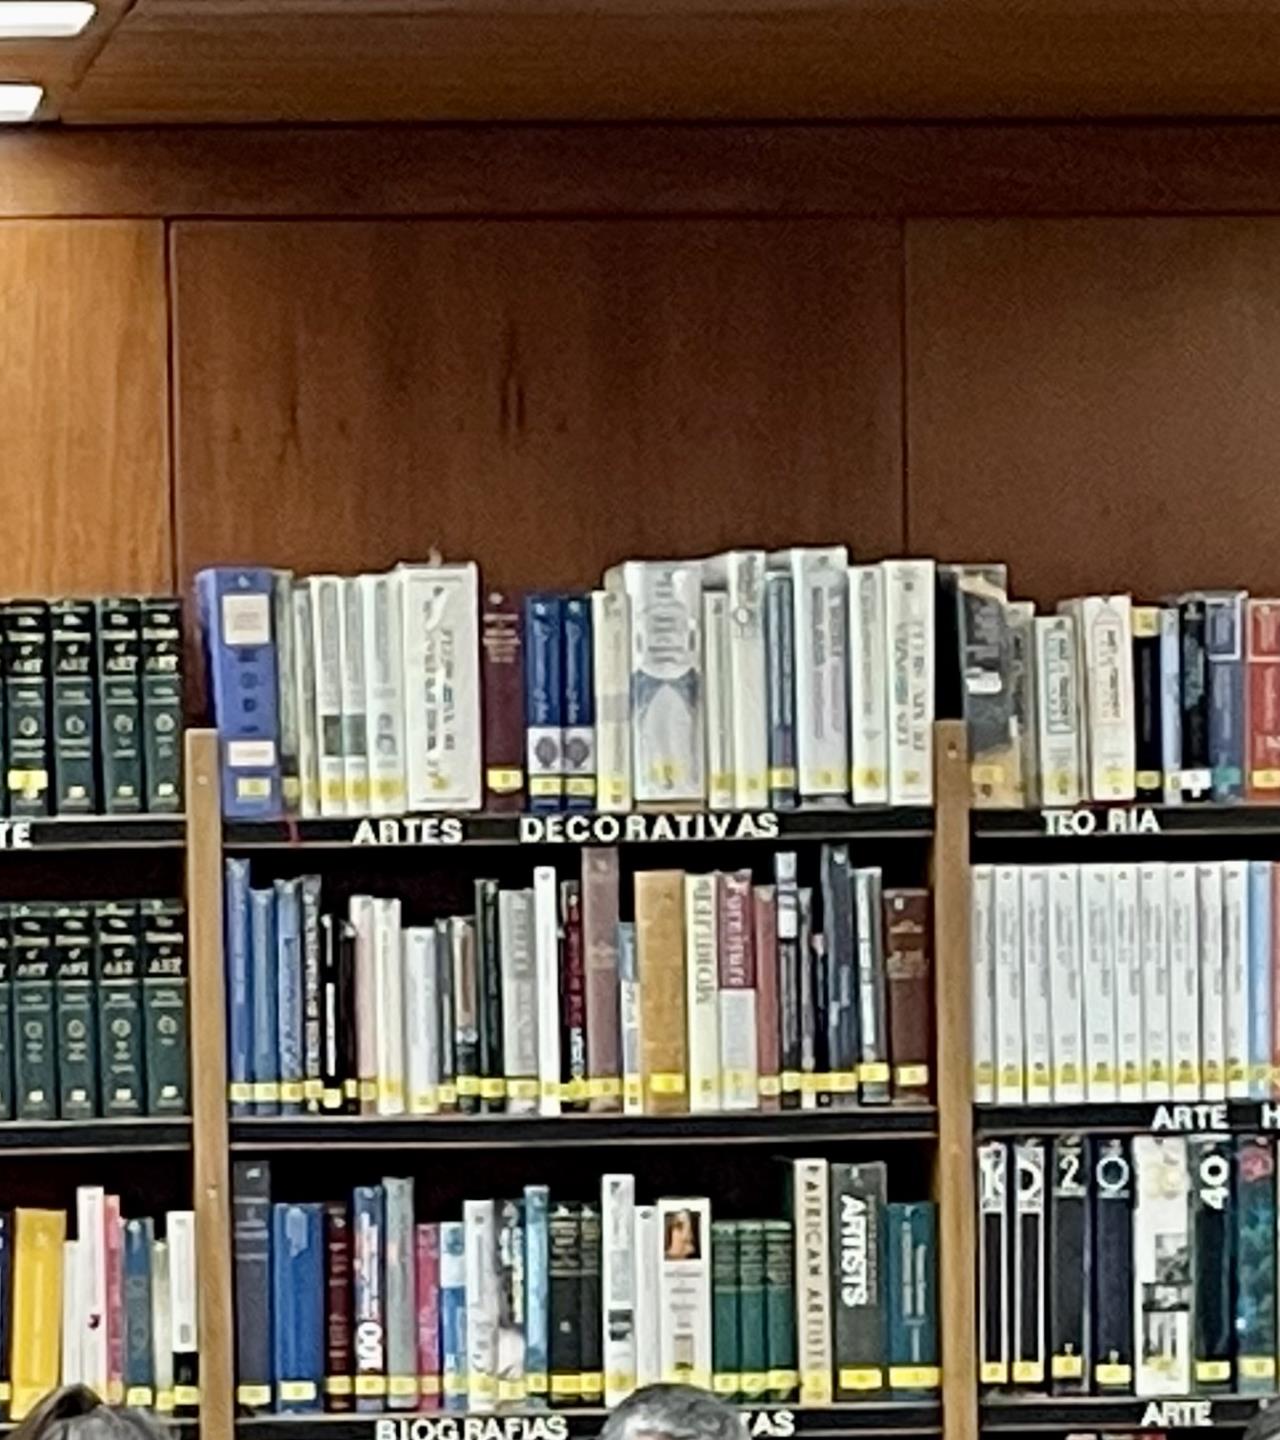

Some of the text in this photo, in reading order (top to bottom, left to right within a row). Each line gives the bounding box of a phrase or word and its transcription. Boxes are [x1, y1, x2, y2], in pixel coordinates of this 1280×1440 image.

[352, 811, 780, 845] ARTES DECORATIVAS
[1151, 1105, 1229, 1132] ARTE
[840, 1194, 868, 1307] ARTISTS
[1140, 1401, 1213, 1427] ARTE
